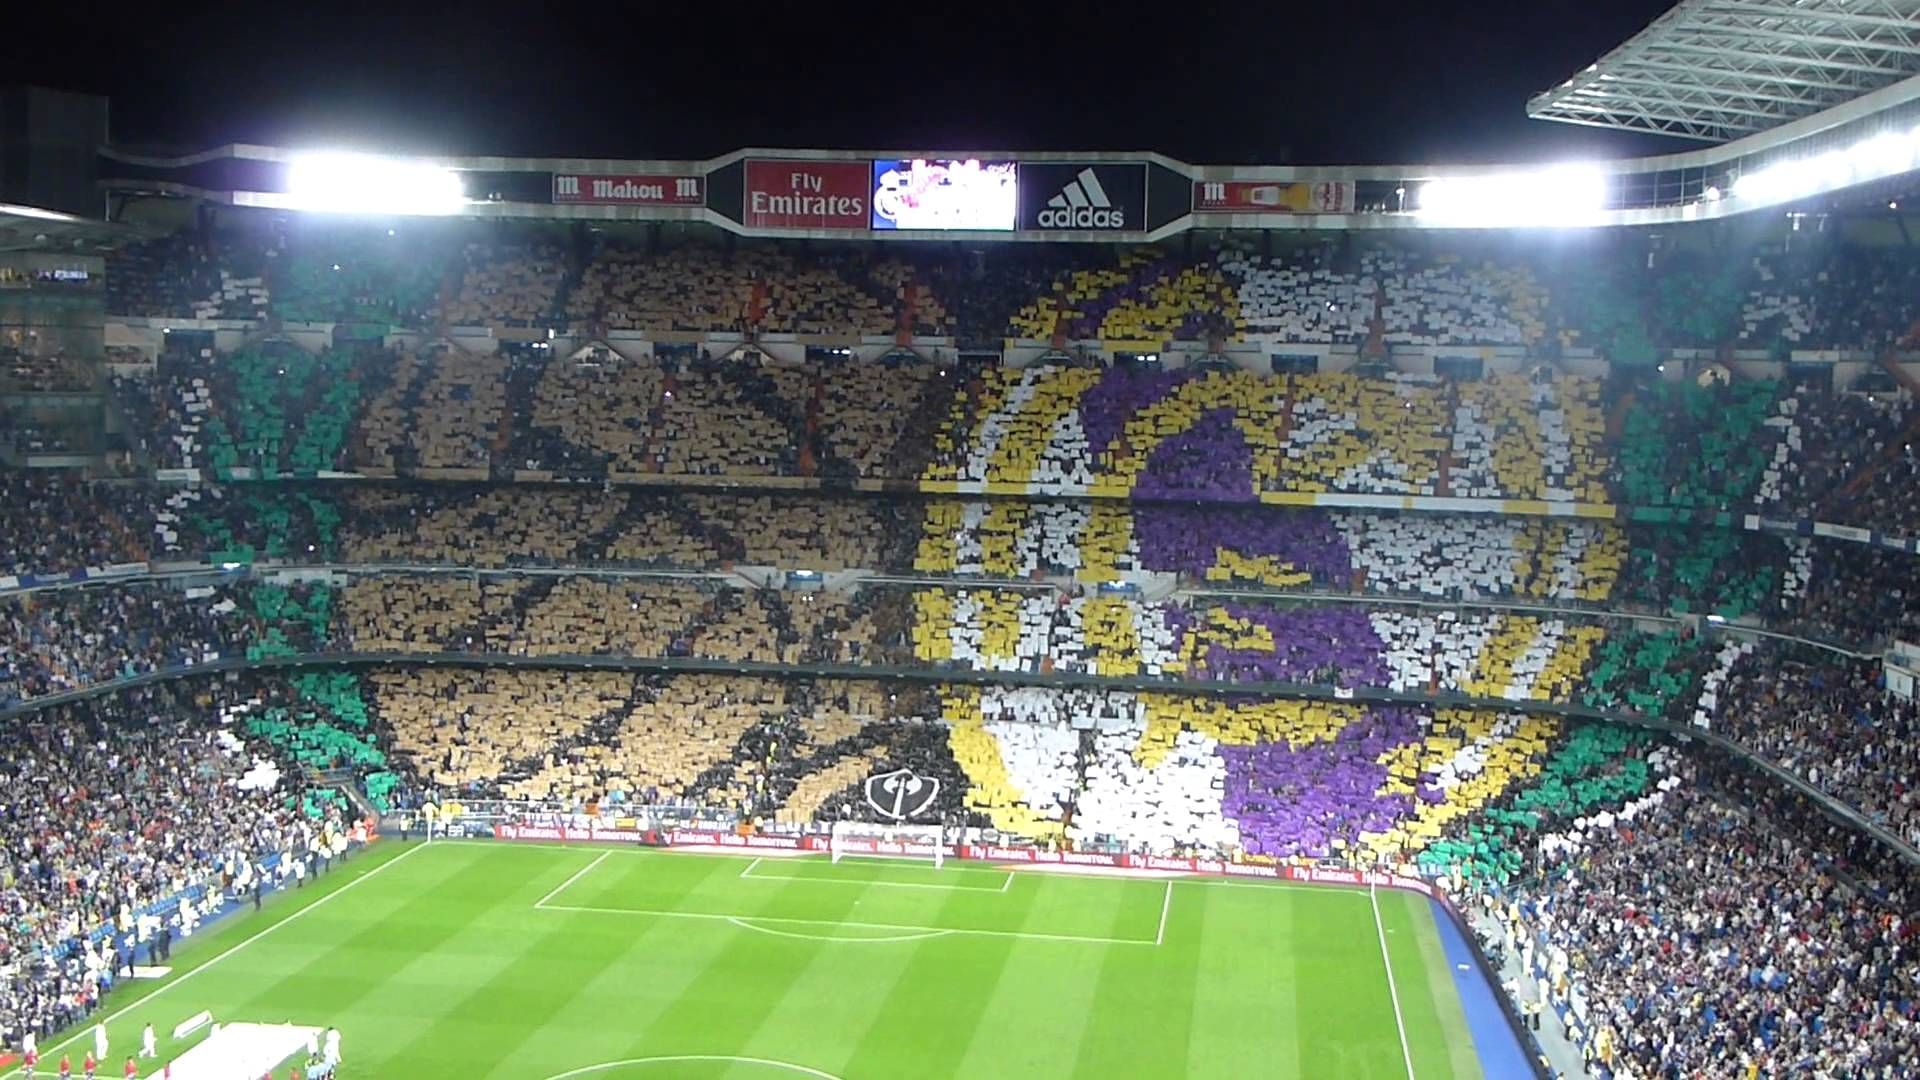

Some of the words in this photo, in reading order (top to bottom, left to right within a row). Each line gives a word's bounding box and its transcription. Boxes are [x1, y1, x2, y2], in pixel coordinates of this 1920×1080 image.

[592, 178, 664, 200] Mahou
[790, 172, 822, 193] Fly
[751, 191, 862, 216] Emirates
[1037, 205, 1125, 228] adidas
